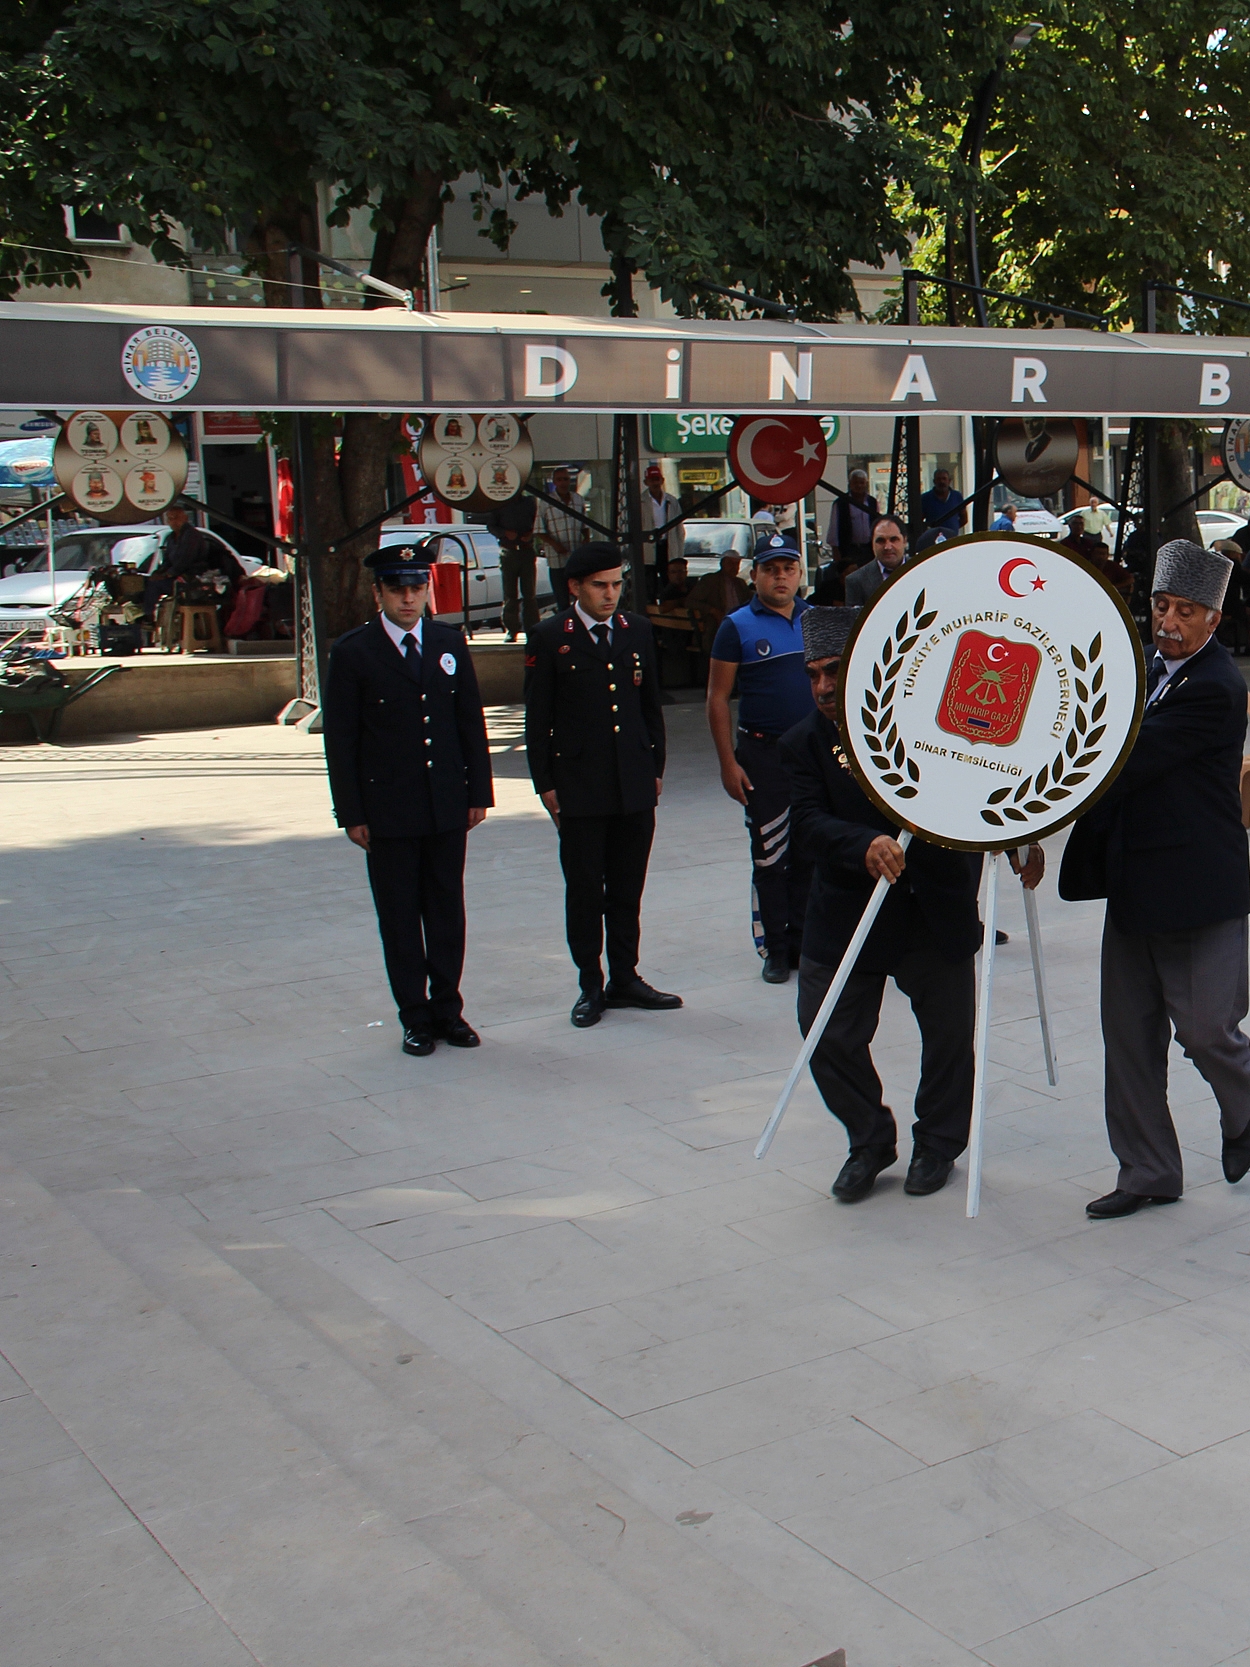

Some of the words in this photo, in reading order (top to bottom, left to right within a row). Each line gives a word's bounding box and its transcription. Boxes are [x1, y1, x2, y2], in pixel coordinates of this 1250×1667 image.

[903, 634, 941, 699] TÜRKİYE
[940, 610, 1010, 637] MUHARİP
[1013, 617, 1063, 665] GAZİLER
[1050, 667, 1070, 740] DERNEĞİ
[991, 711, 1009, 724] GAZİ
[914, 740, 948, 757] DİNAR
[951, 750, 1023, 777] TEMSİLCİLİĞİ
